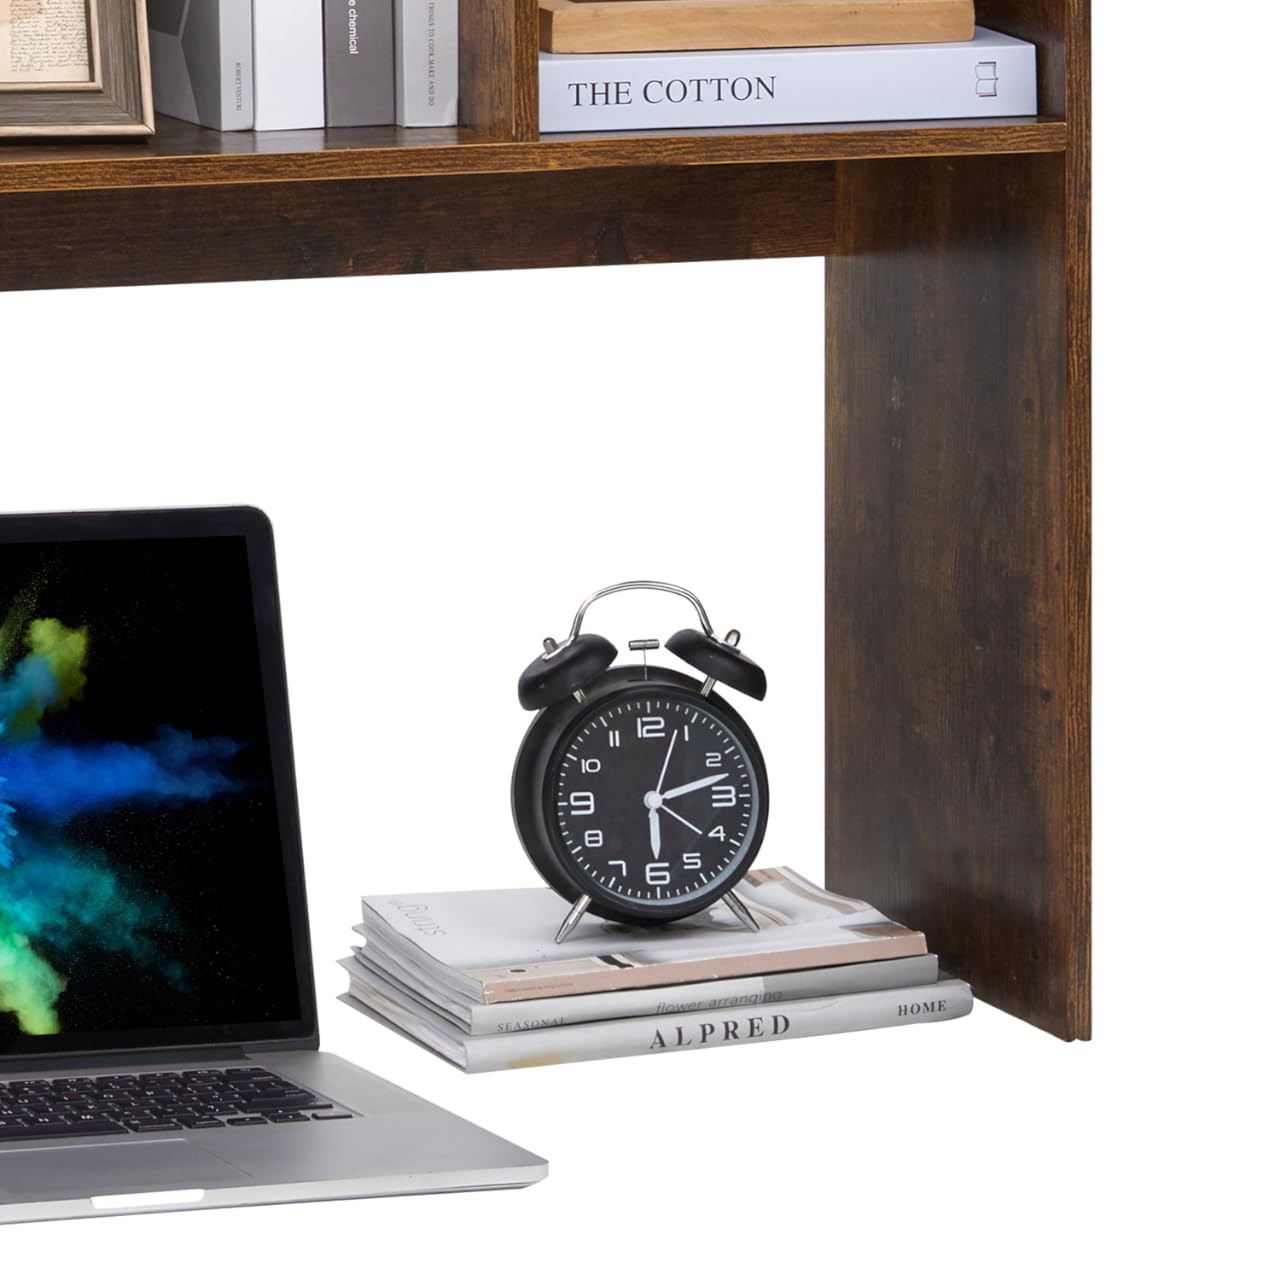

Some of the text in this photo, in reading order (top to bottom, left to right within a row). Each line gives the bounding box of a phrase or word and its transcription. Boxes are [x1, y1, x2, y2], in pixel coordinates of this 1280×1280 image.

[348, 9, 359, 54] chemical
[568, 75, 777, 107] THE COTTON
[637, 717, 666, 738] 12
[684, 725, 689, 742] 1
[609, 730, 620, 747] 11
[581, 758, 601, 773] 10
[705, 752, 722, 767] 2
[570, 791, 595, 816] 9
[711, 785, 737, 808] 3
[584, 830, 604, 848] 8
[708, 825, 726, 842] 4
[608, 860, 627, 877] 7
[682, 853, 702, 869] 5
[645, 862, 671, 885] 6
[656, 991, 783, 1014] flower arranging
[897, 1000, 948, 1017] HOME
[497, 1017, 566, 1032] SEASONAL
[649, 1014, 791, 1050] ALPRED
